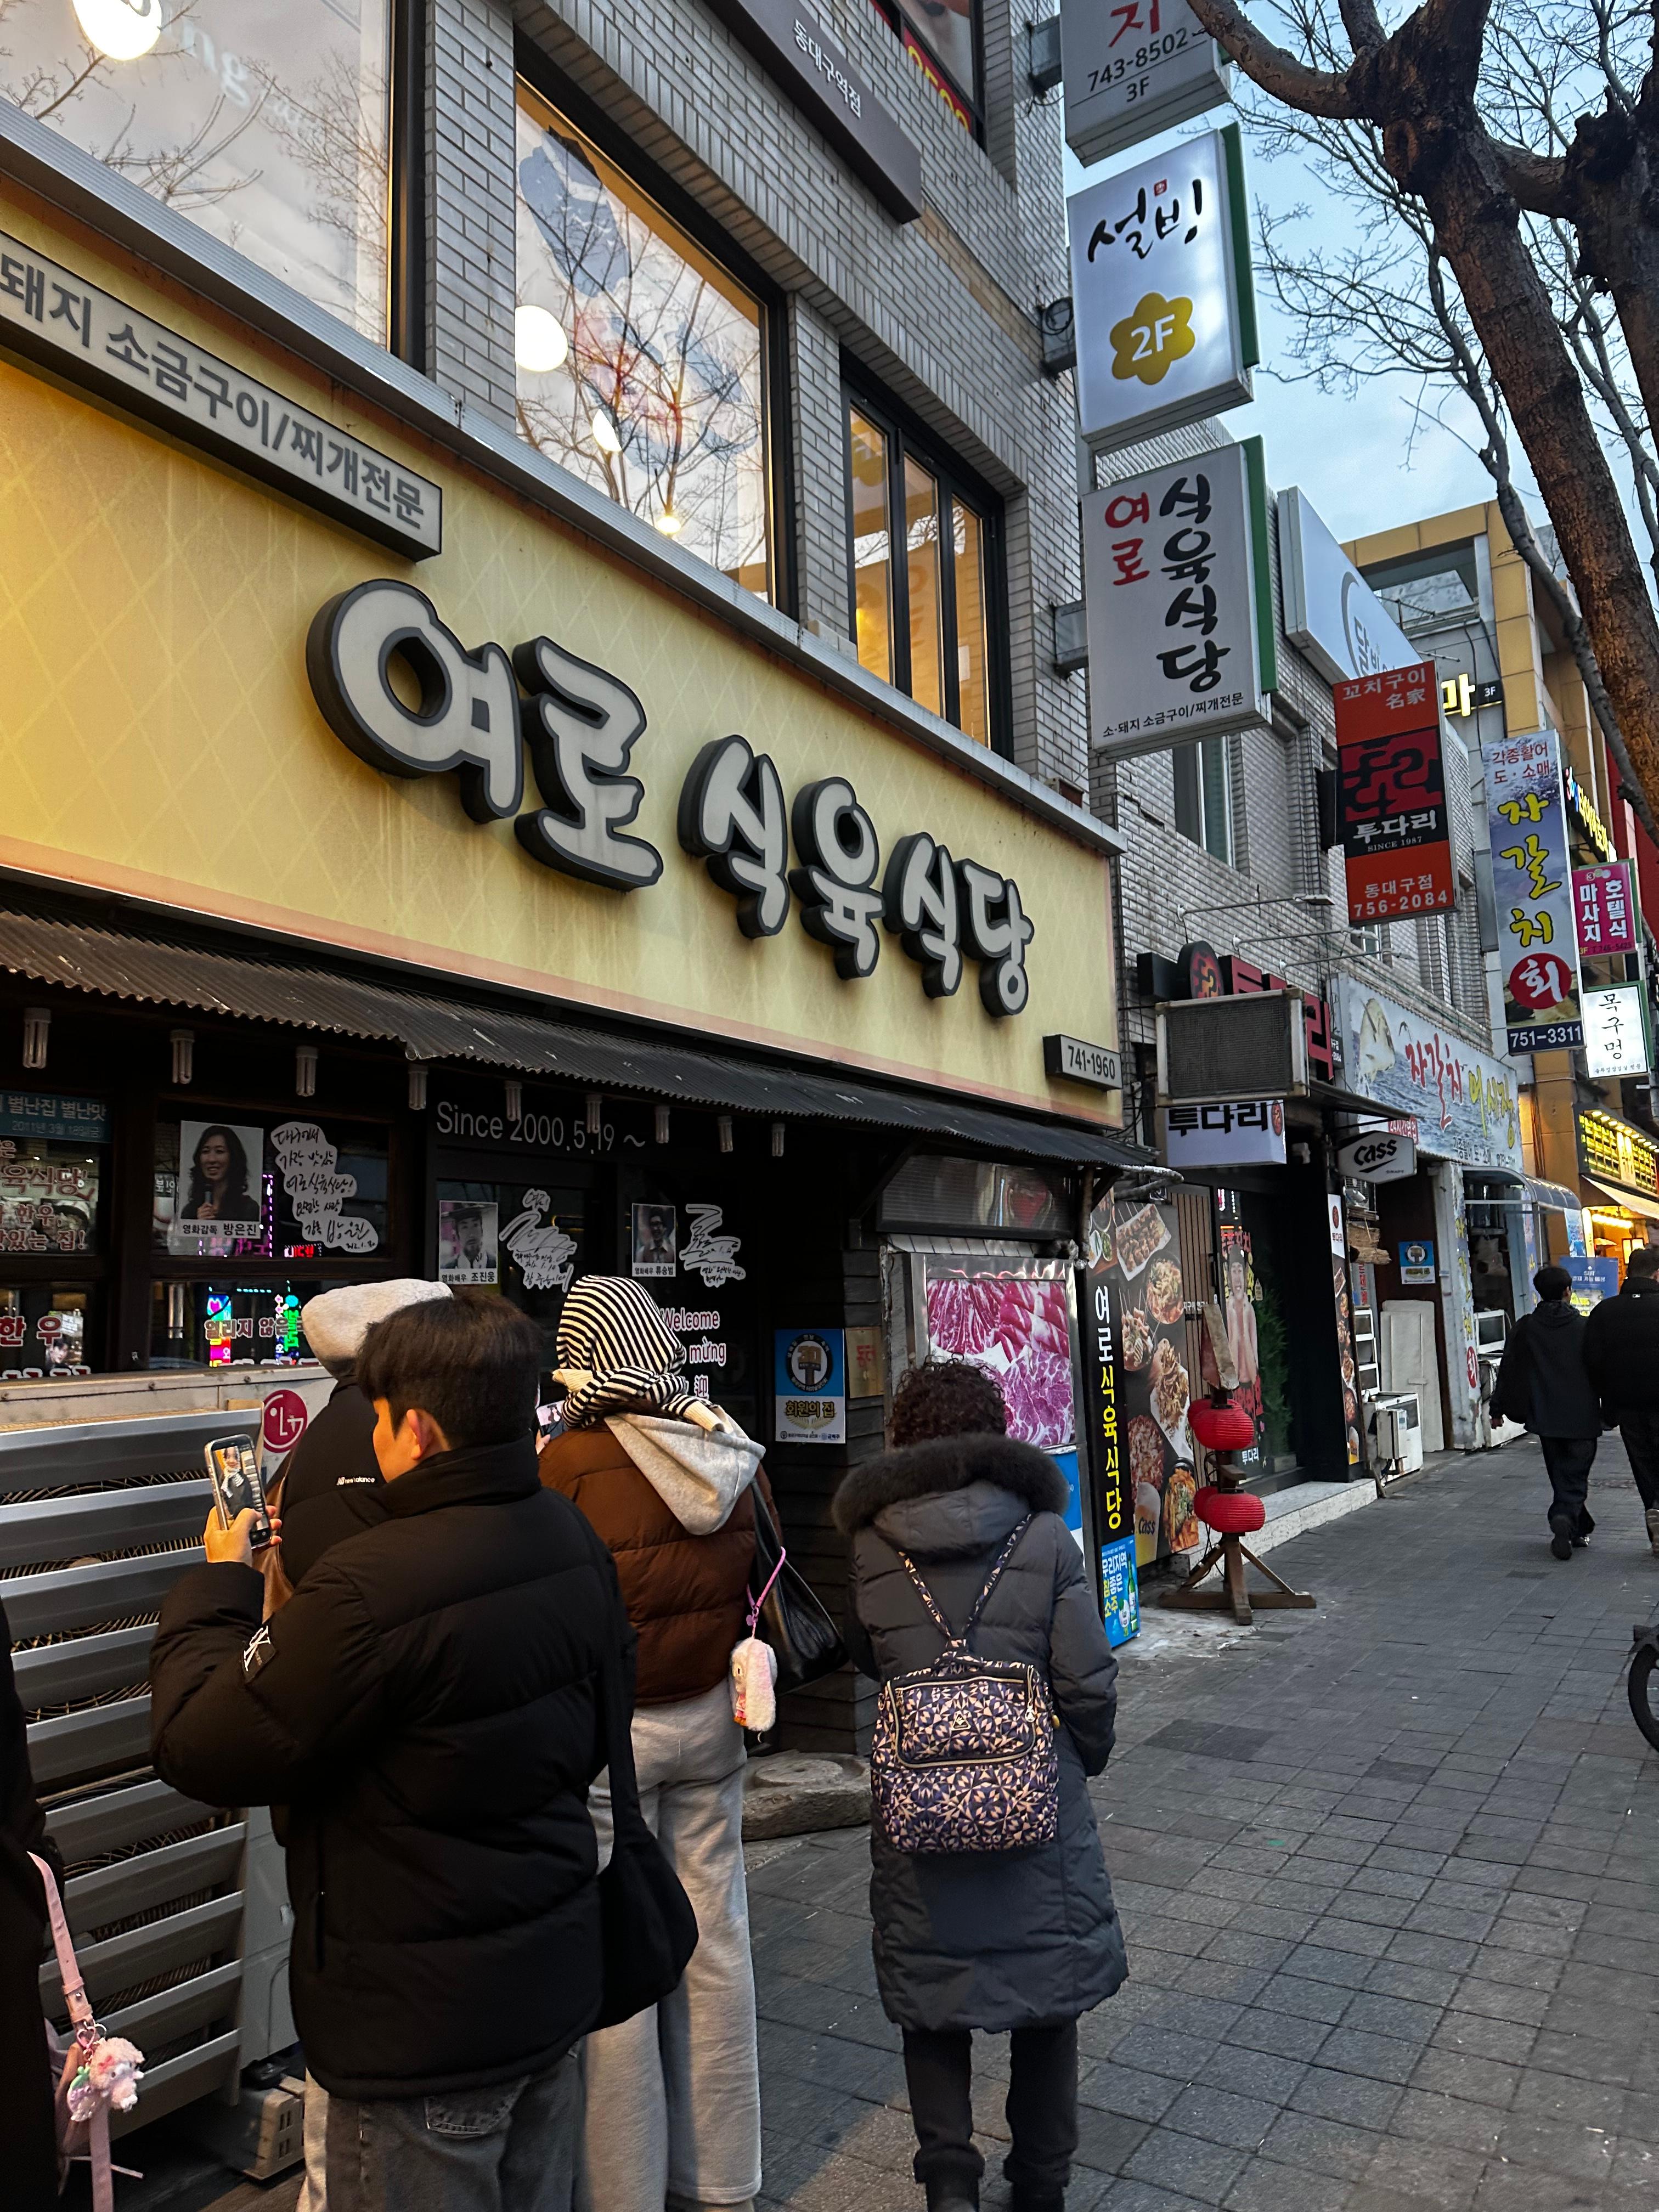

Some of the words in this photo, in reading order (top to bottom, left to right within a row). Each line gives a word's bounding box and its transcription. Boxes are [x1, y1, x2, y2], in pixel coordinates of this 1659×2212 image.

[794, 19, 861, 119] 동대구역점
[1087, 28, 1188, 92] 743-8502
[1126, 76, 1150, 103] 3F
[1088, 179, 1204, 263] 설빙
[1130, 315, 1175, 361] 2F
[0, 253, 92, 348] 돼지
[106, 324, 424, 530] 소금구이/찌개전문
[1104, 492, 1150, 586] 여로
[1156, 473, 1231, 692] 식육식당
[1342, 667, 1426, 700] 꼬치구이
[1485, 686, 1496, 697] 3F
[1143, 692, 1244, 727] 소금구이/찌개전문
[1386, 689, 1425, 709] 名家
[1492, 741, 1548, 765] 각종활어
[306, 578, 664, 891] 여로
[676, 733, 1034, 1019] 식육식당
[1353, 809, 1437, 845] 투다리
[1368, 840, 1398, 853] SINCE
[1401, 836, 1422, 848] 1987
[1498, 794, 1563, 948] 자갈치
[1364, 875, 1433, 899] 동대구점
[1353, 890, 1448, 918] 756-2084
[1580, 883, 1602, 943] 마사지
[1605, 879, 1628, 939] 호텔식
[1519, 958, 1563, 1003] 회
[1510, 1025, 1582, 1048] 751-3311
[1599, 994, 1624, 1059] 목구멍
[1068, 1043, 1116, 1081] 741-1960
[1406, 1032, 1463, 1132] 자갈치
[8, 1096, 55, 1117] 별난집
[61, 1101, 106, 1121] 별난맛
[437, 1101, 504, 1138] Since
[1169, 1102, 1267, 1137] 투다리
[12, 1120, 46, 1133] 2011년
[48, 1124, 65, 1136] 3월
[1353, 1139, 1397, 1166] Cass
[57, 1229, 86, 1251] 집!
[183, 1224, 217, 1234] 영화감독
[223, 1223, 256, 1236] 방은진
[442, 1273, 466, 1284] 영화배우
[471, 1271, 494, 1283] 조진웅
[656, 1266, 673, 1276] 류승범
[204, 1318, 253, 1340] 얼리지
[660, 1308, 720, 1331] Welcome
[786, 1401, 820, 1417] 회원의
[822, 1401, 835, 1418] 집
[1242, 1447, 1259, 1465] 투다리
[1102, 1551, 1127, 1578] 우리지역
[1104, 1595, 1119, 1618] 소주
